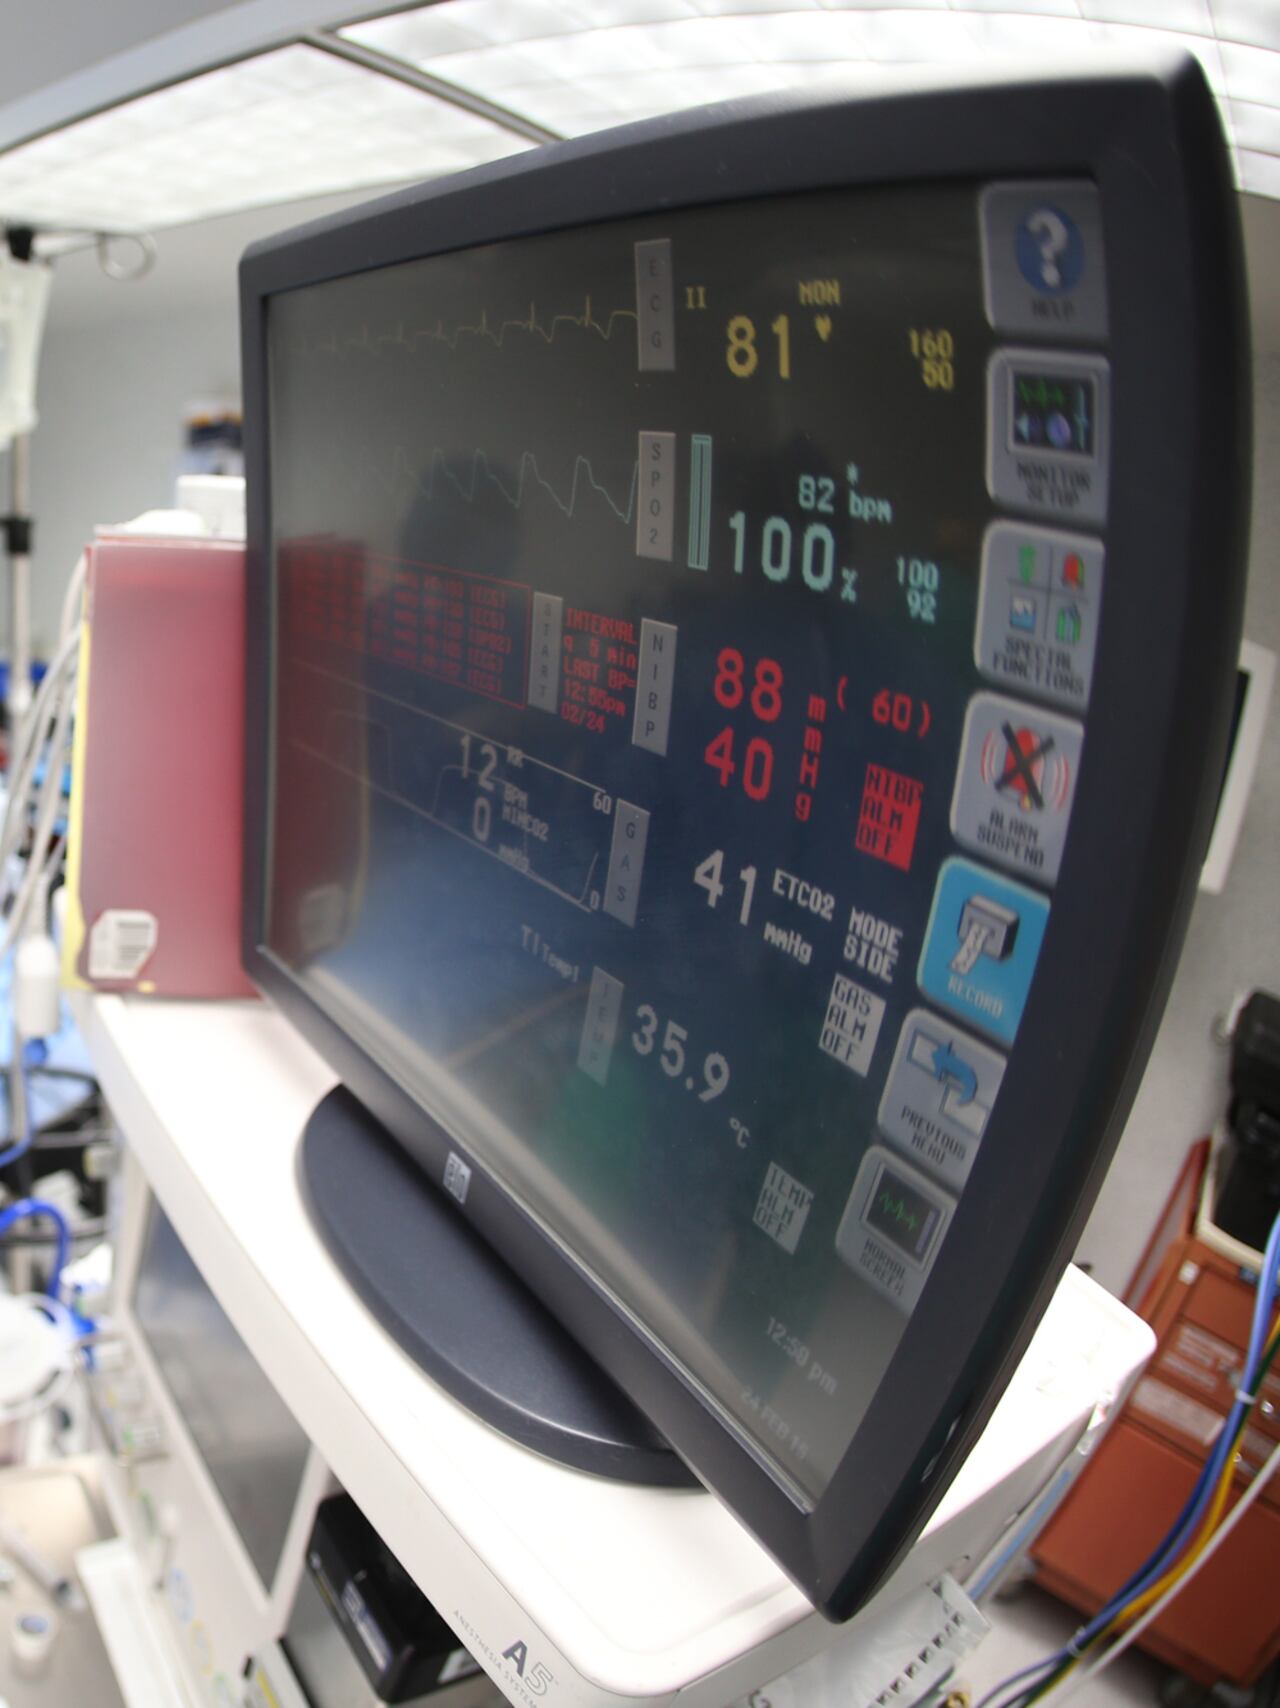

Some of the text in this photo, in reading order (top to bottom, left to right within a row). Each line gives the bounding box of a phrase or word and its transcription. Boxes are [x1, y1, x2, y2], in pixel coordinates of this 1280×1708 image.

[647, 257, 663, 350] ECG
[726, 315, 790, 379] 81
[910, 328, 954, 360] 160
[922, 358, 955, 392] 50
[798, 474, 893, 524] 82 bpm
[729, 510, 858, 602] 100 %
[897, 556, 939, 592] 100
[907, 589, 937, 624] 92
[644, 633, 665, 738] NIBP
[714, 647, 784, 723] 88
[461, 734, 497, 792] 12
[704, 725, 774, 801] 40
[592, 791, 613, 816] 60
[615, 821, 636, 903] GAS
[693, 849, 837, 926] 41 ETCO2
[848, 905, 903, 956] MODE
[843, 934, 899, 985] SIDE
[826, 1002, 867, 1042] ALM
[834, 976, 871, 1017] GAS
[947, 975, 1004, 1020] RECORD
[632, 1004, 731, 1104] 35.9
[821, 1028, 860, 1064] OFF
[501, 1639, 555, 1697] A5
